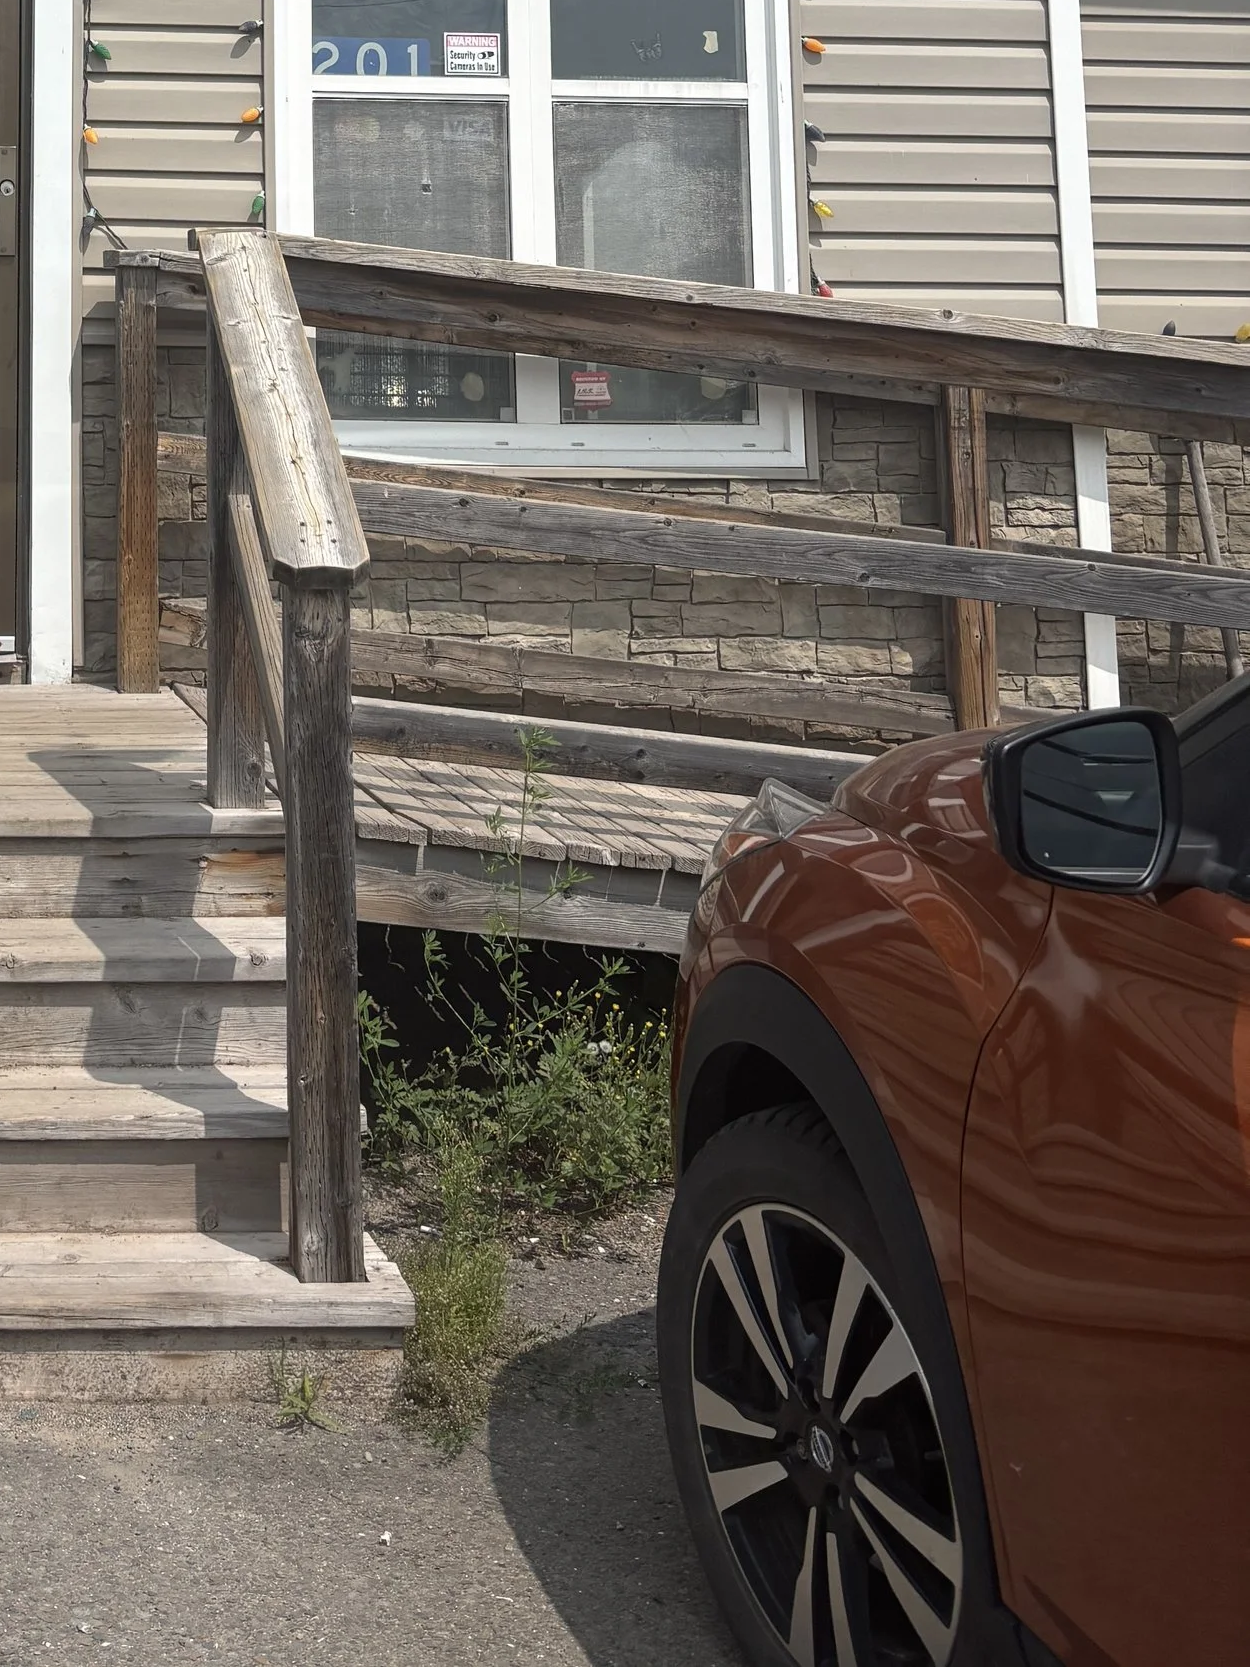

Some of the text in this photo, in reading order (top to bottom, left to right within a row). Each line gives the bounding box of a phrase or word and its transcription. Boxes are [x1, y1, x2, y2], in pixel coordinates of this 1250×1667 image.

[449, 36, 495, 47] WARNING
[312, 40, 419, 76] 201
[450, 50, 476, 62] Security
[450, 61, 495, 71] Cameras In Use
